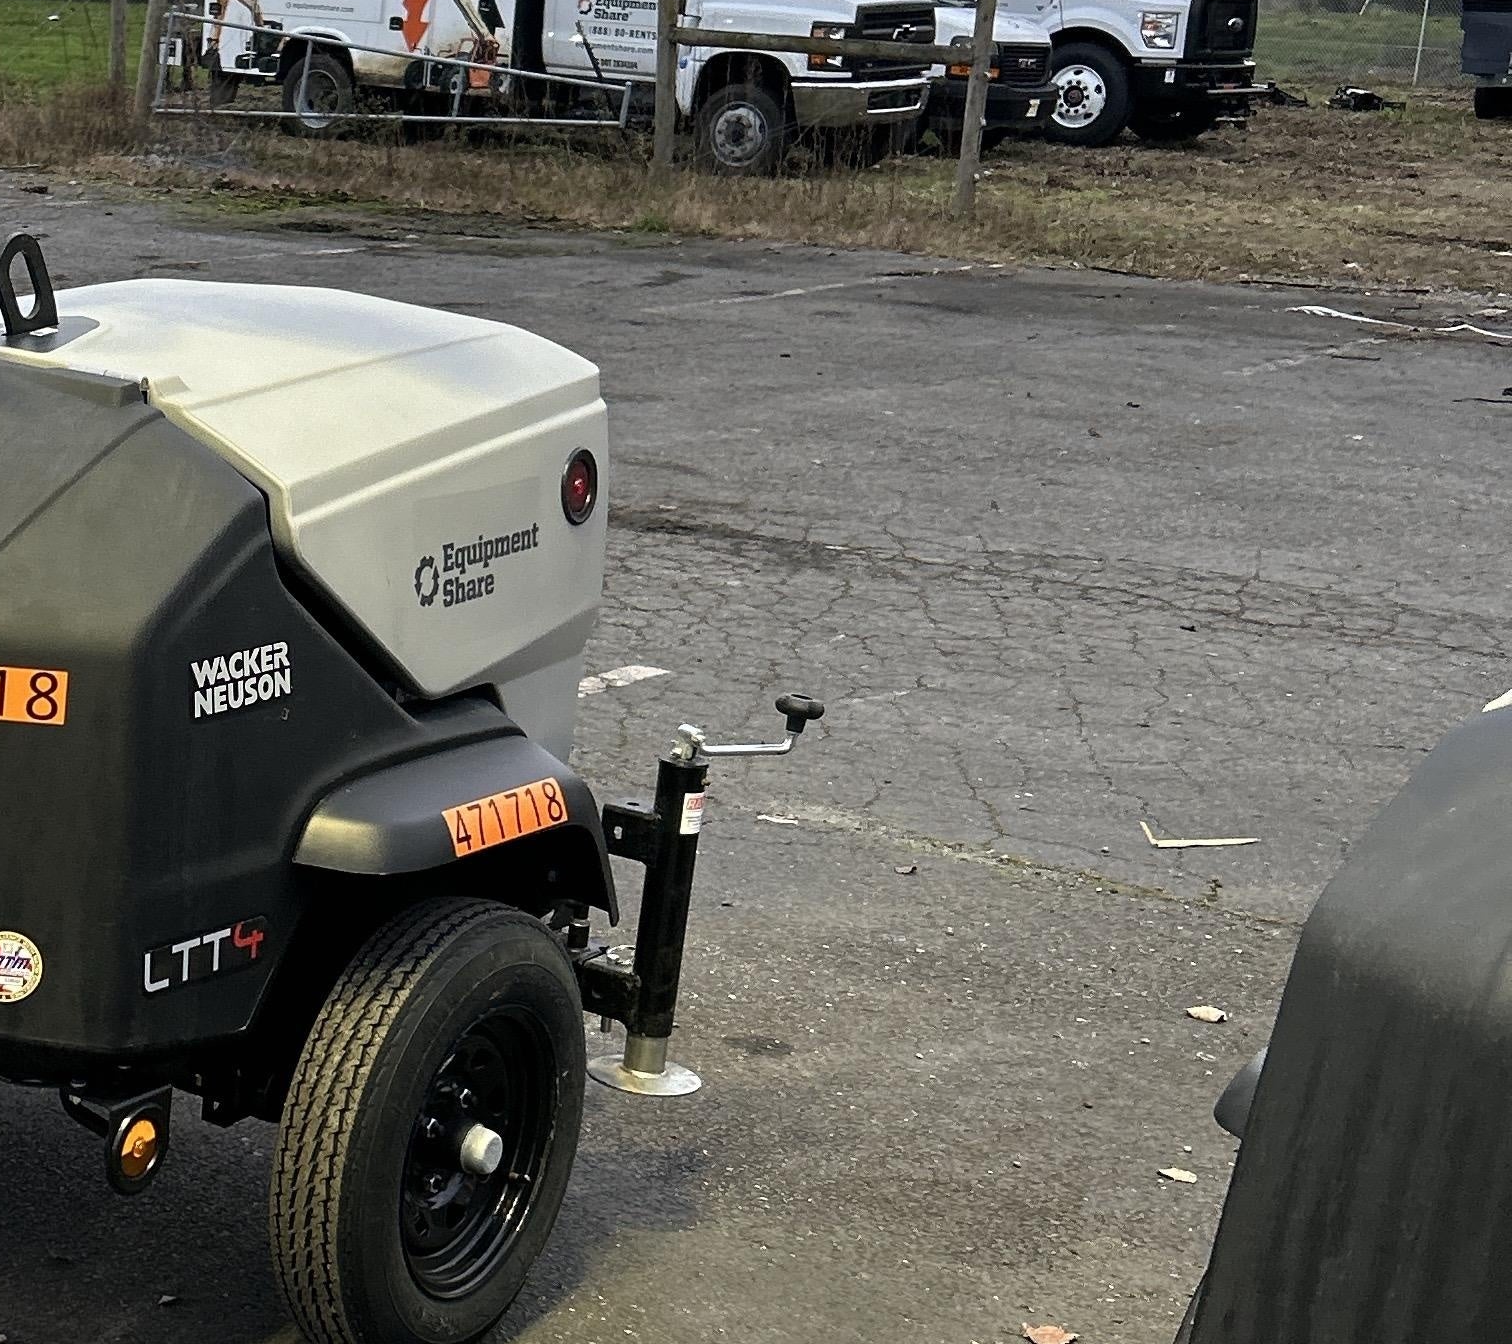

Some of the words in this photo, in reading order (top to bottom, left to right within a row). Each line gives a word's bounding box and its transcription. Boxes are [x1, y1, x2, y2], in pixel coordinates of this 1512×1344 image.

[593, 8, 630, 22] Share
[442, 522, 540, 575] Equipment
[442, 573, 495, 607] Share
[190, 641, 291, 689] WACKER
[194, 667, 292, 719] NEUSON
[455, 781, 564, 851] 471718
[144, 920, 265, 993] LTT4
